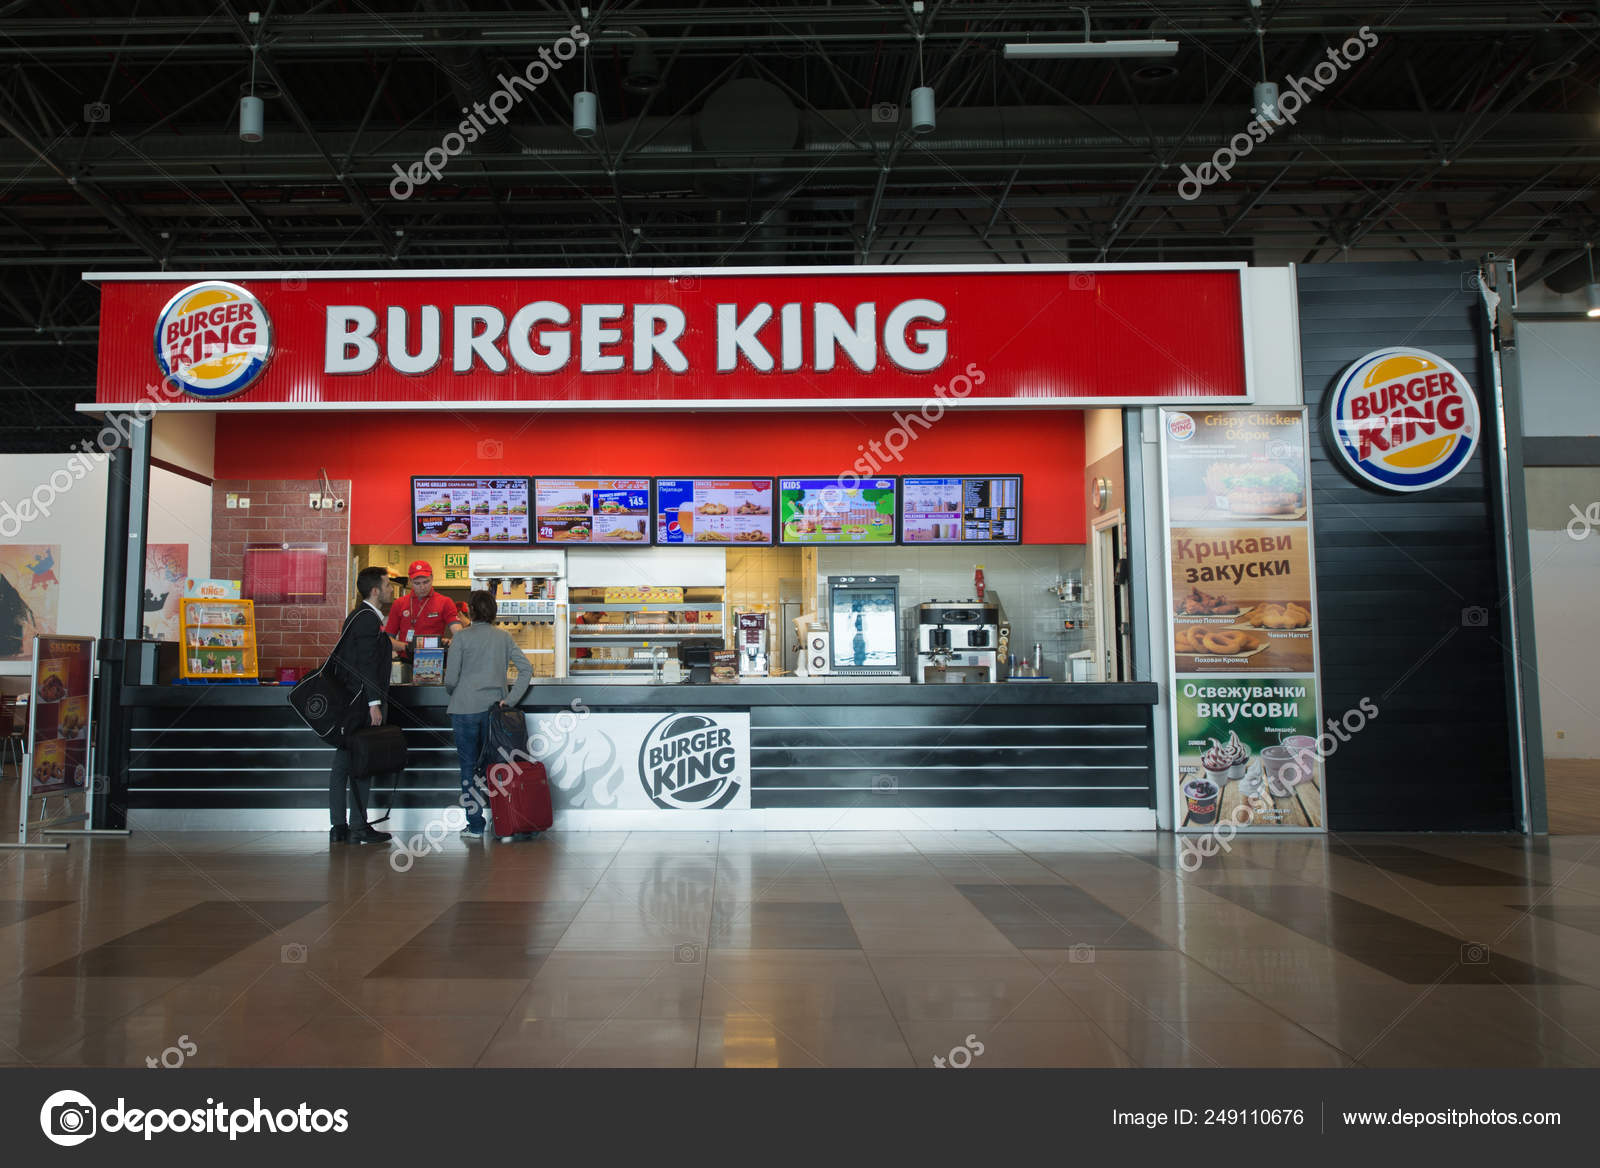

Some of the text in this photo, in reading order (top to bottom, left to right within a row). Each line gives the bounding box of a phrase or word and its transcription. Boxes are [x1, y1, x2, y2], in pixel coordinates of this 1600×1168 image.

[166, 302, 254, 345] BURGER
[169, 321, 257, 374] KING
[324, 299, 949, 376] BURGER KING
[1351, 372, 1457, 421] BURGER
[1171, 423, 1192, 433] KING
[1204, 413, 1300, 428] Crispy Chicken
[1358, 395, 1465, 461] KING
[1225, 429, 1270, 442] Оброк
[783, 481, 801, 490] KIDS
[628, 496, 644, 507] 145
[540, 527, 553, 536] 270
[447, 554, 465, 566] EXIT
[1177, 534, 1293, 563] Крцкави
[1186, 559, 1291, 585] закуски
[1183, 683, 1306, 703] Освежувачки
[1196, 702, 1299, 724] вкусови
[649, 728, 732, 769] BURGER
[653, 747, 736, 797] KING
